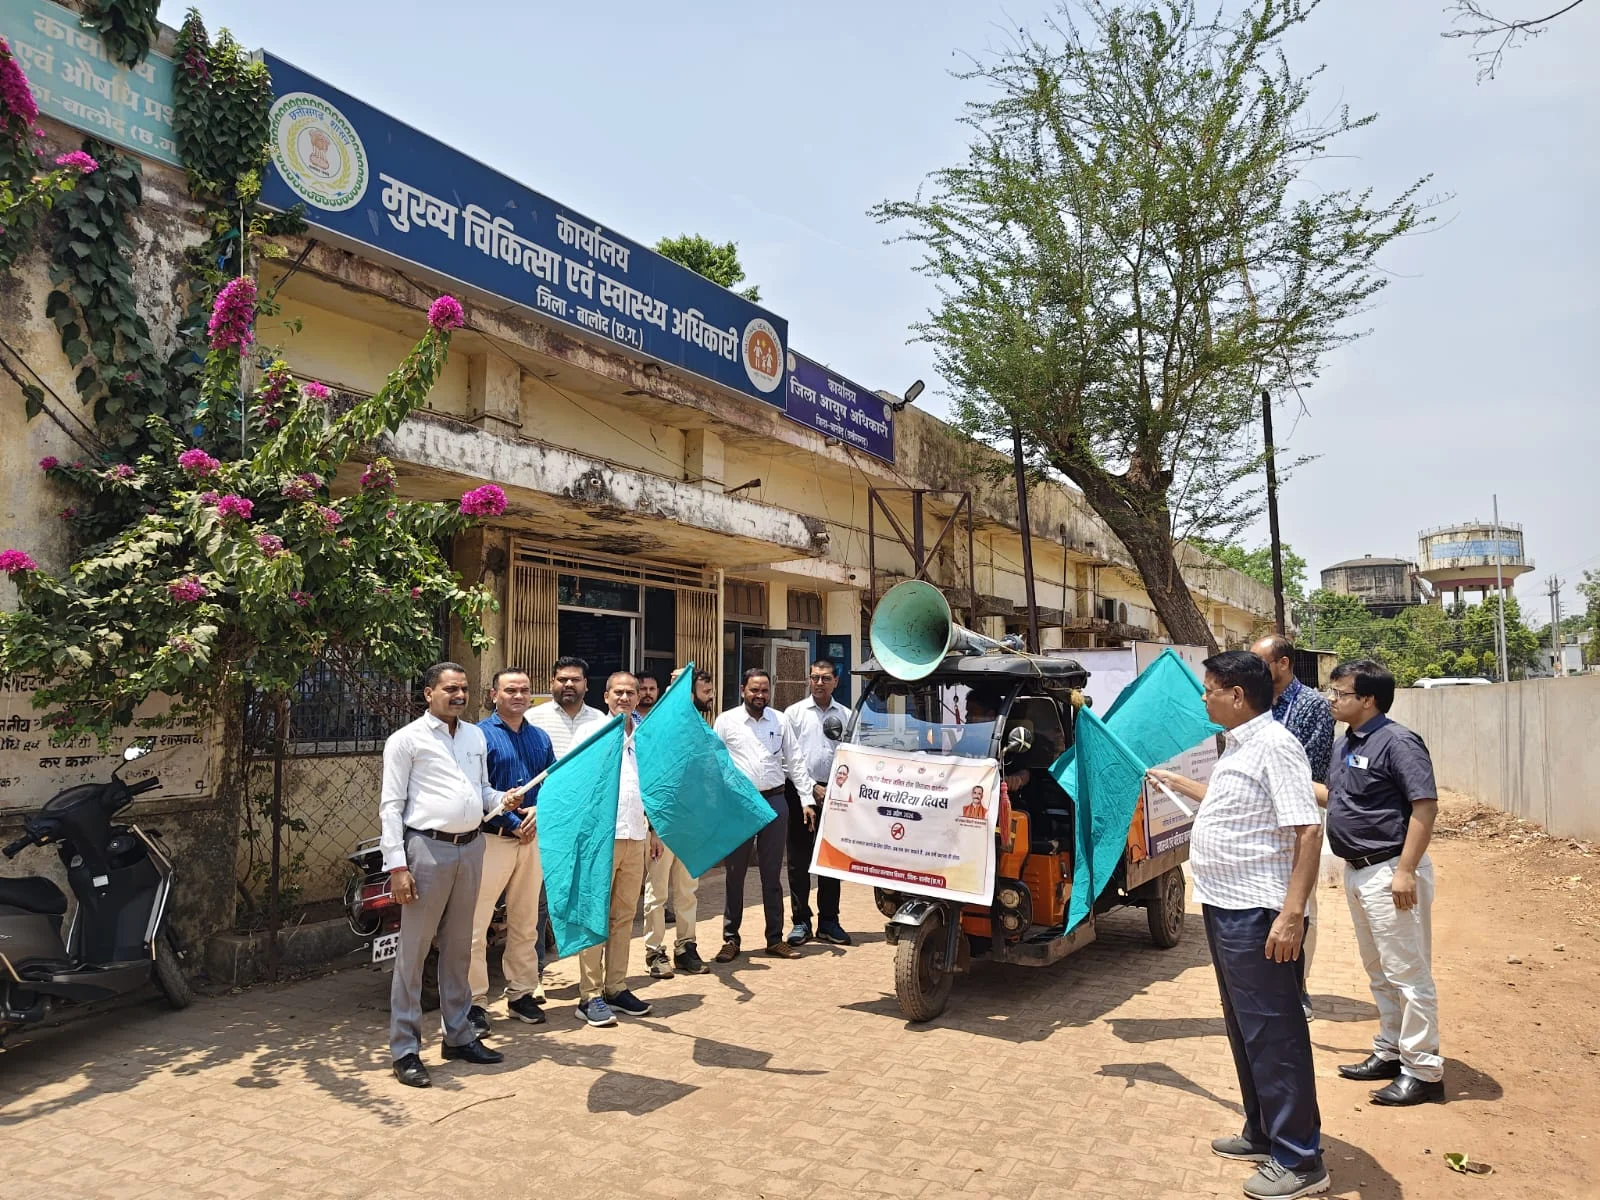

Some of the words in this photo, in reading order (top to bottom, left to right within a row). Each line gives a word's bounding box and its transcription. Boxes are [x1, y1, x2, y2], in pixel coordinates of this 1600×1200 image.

[14, 39, 55, 74] एवं
[379, 172, 459, 240] मुख्य
[462, 204, 562, 285] चिकित्सा
[564, 259, 596, 300] एवं
[598, 273, 668, 331] स्वास्थ्य
[671, 307, 739, 362] अधिकारी
[555, 214, 630, 273] कार्यालय
[536, 284, 568, 317] जिला
[576, 305, 610, 334] बालोद
[611, 316, 644, 350] (छ.ग.)
[790, 375, 817, 404] जिला
[820, 394, 848, 421] आयुष
[849, 409, 888, 438] अधिकारी
[827, 378, 857, 404] कार्यालय
[859, 784, 880, 800] विश्व
[882, 790, 921, 806] मलेरिया
[921, 794, 949, 809] दिवस
